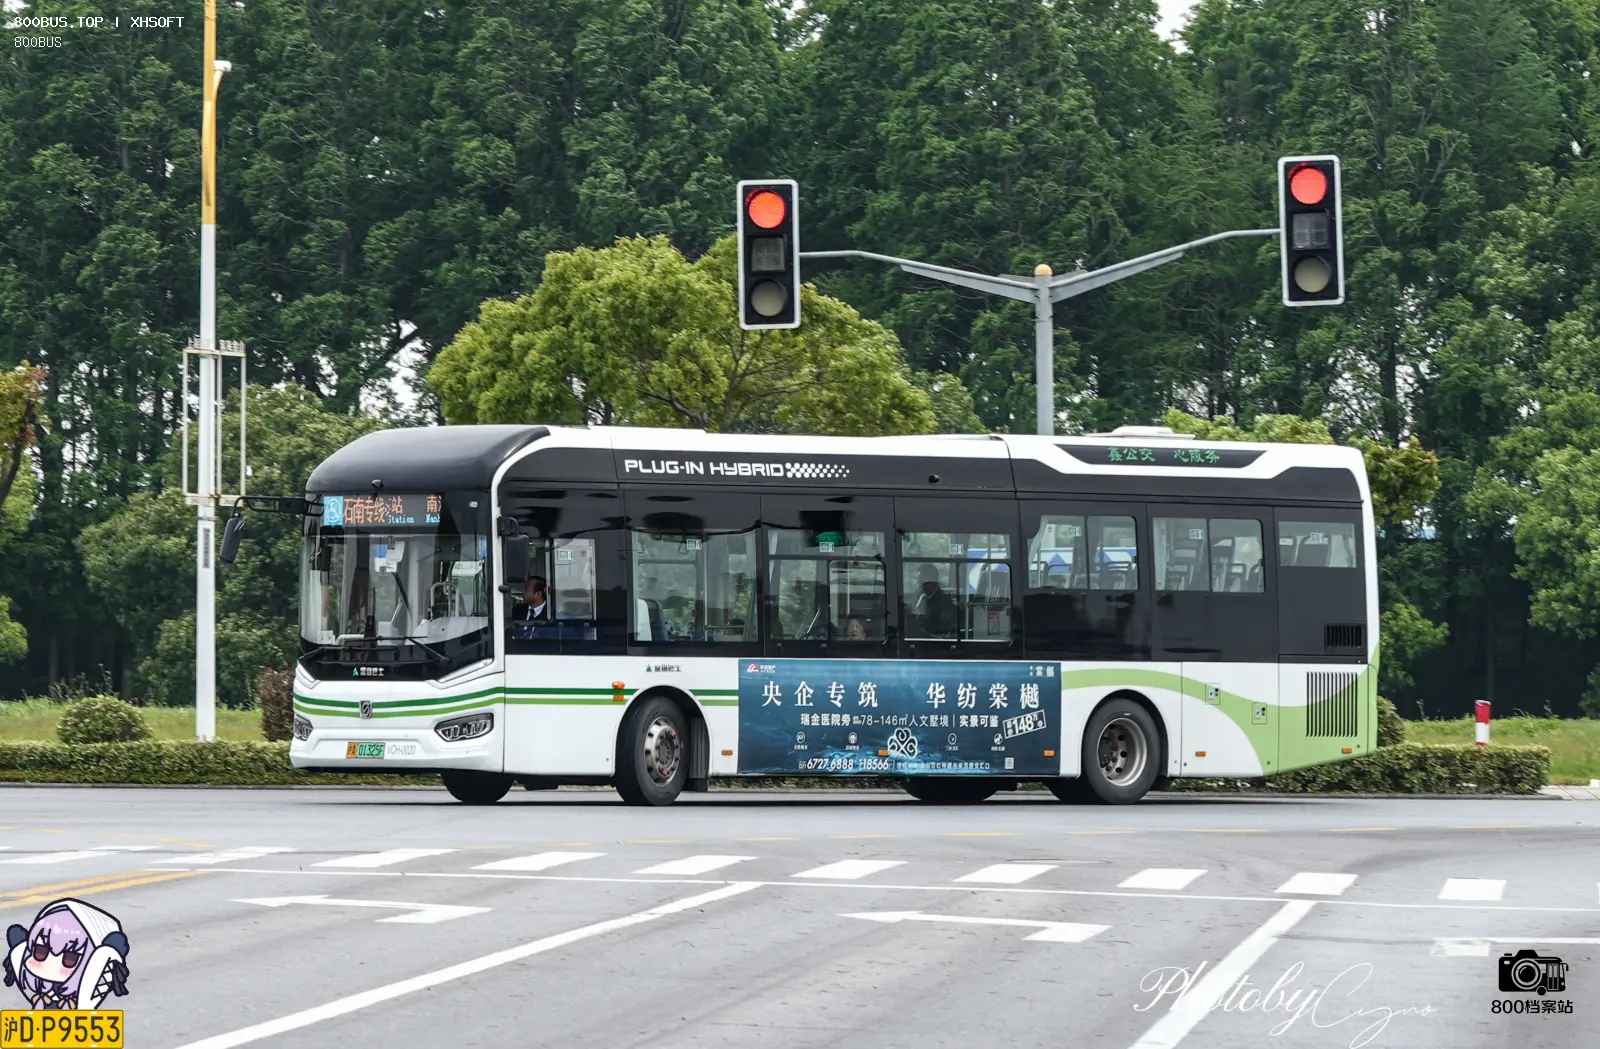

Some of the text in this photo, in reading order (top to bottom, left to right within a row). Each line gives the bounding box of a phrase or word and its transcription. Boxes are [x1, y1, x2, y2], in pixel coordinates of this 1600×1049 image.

[1107, 447, 1221, 464] 鑫公交 心服务
[624, 459, 784, 477] PLUG-IN HYBRID
[761, 680, 1040, 710] 央企专筑 华纺棠樾
[800, 713, 851, 727] 瑞金医院旁
